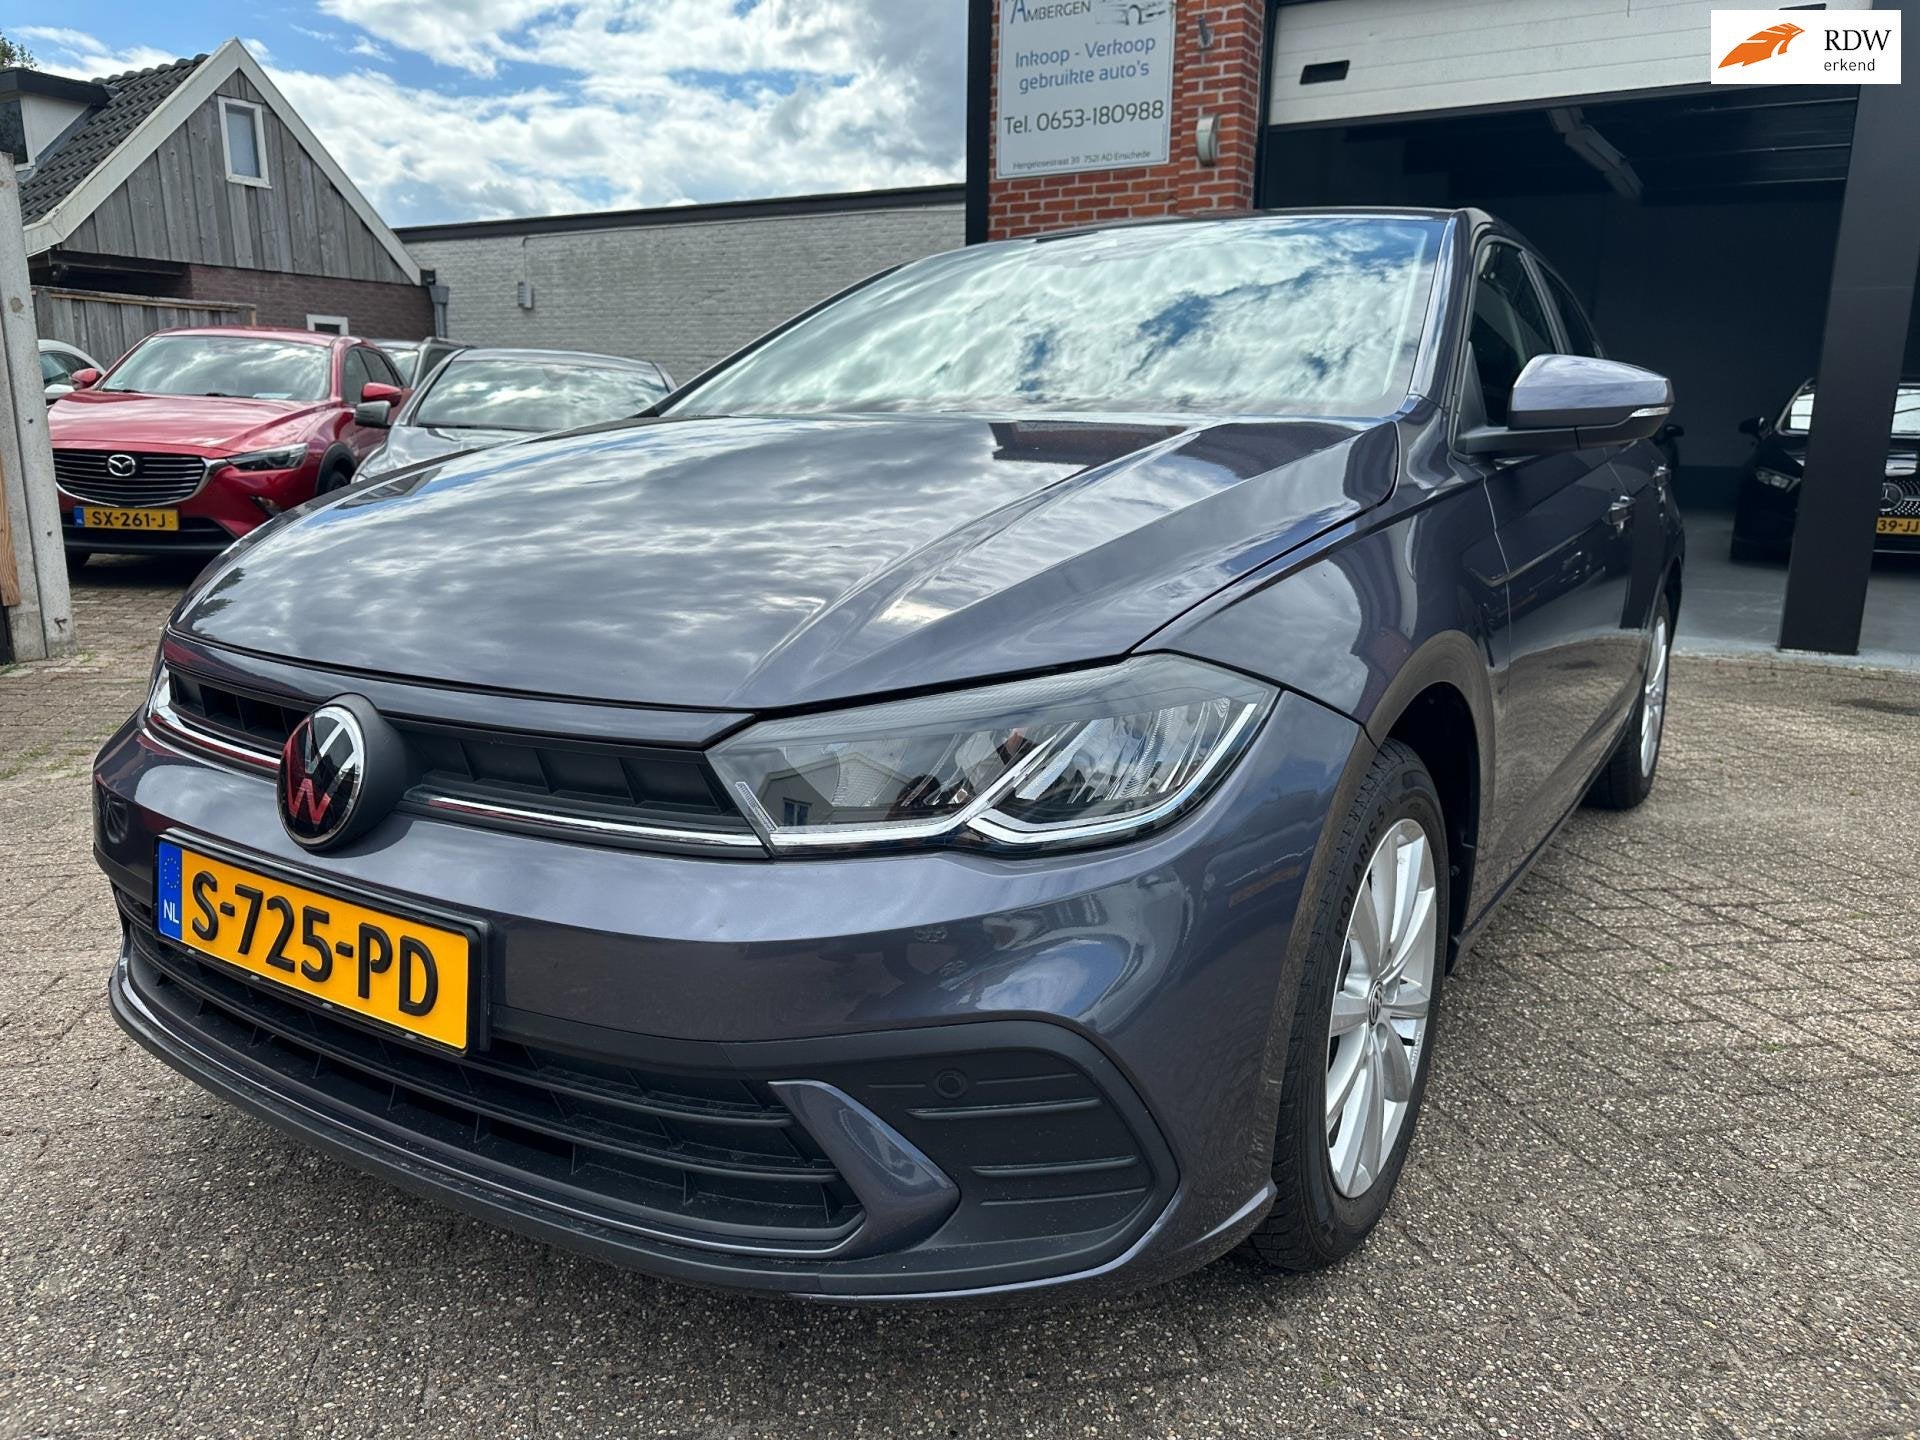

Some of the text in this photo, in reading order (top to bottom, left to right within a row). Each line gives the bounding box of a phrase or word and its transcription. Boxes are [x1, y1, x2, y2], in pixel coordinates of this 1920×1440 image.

[1015, 48, 1070, 68] Inkoop
[1084, 37, 1156, 59] Verkoop
[1019, 60, 1150, 94] gebruikte auto's
[1004, 99, 1164, 135] Tel. 0653-180988
[91, 510, 166, 528] SX-261-J
[163, 898, 180, 925] NL
[191, 870, 439, 1017] S-725-PD
